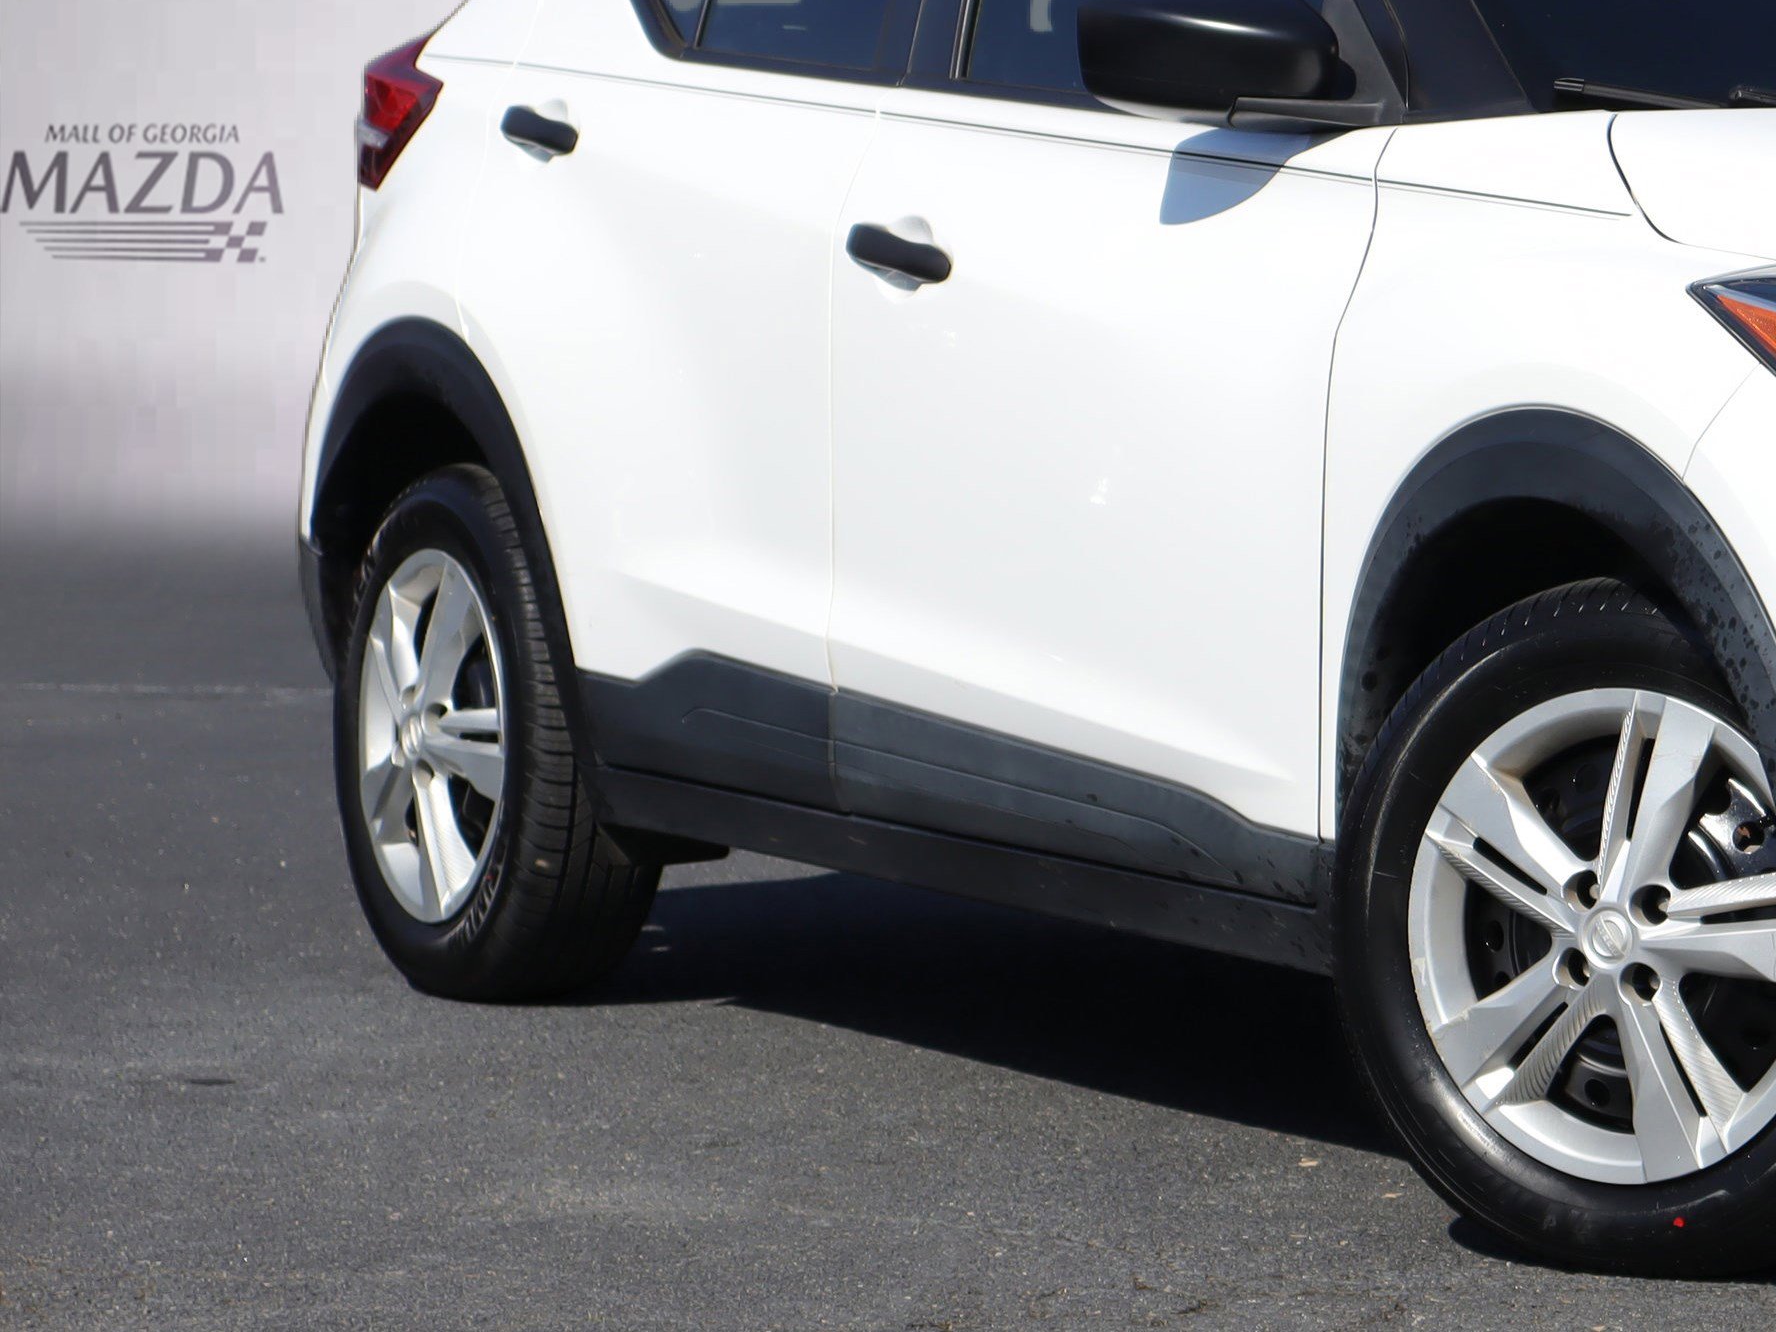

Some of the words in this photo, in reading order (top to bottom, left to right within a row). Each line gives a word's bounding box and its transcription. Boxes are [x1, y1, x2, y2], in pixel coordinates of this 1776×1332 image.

[45, 124, 99, 143] MALL
[107, 124, 136, 144] OF
[142, 124, 239, 144] GEORGIA
[0, 150, 284, 214] MAZDA
